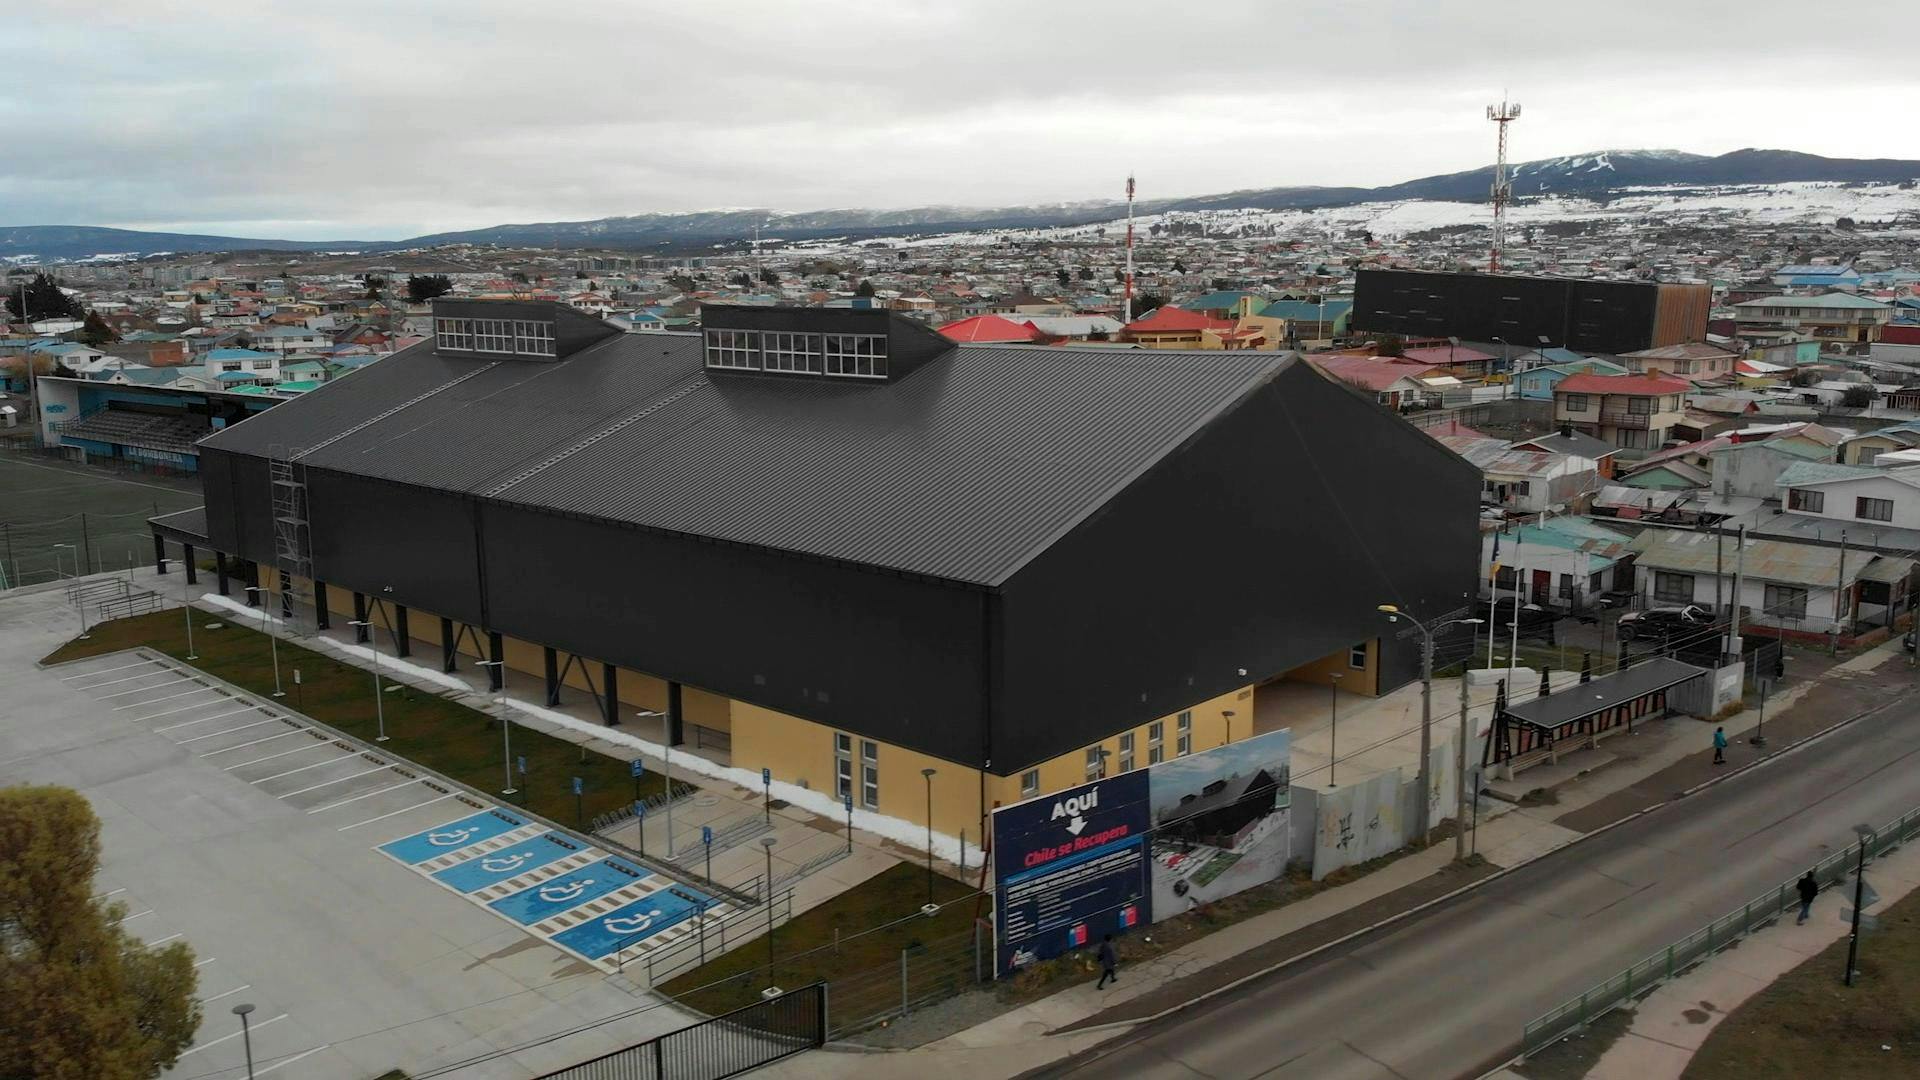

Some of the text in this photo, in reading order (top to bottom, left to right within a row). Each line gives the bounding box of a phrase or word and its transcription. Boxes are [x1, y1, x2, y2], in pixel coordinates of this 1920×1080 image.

[1050, 786, 1099, 821] AQUÍ
[1024, 824, 1129, 867] Chile se Recupera
